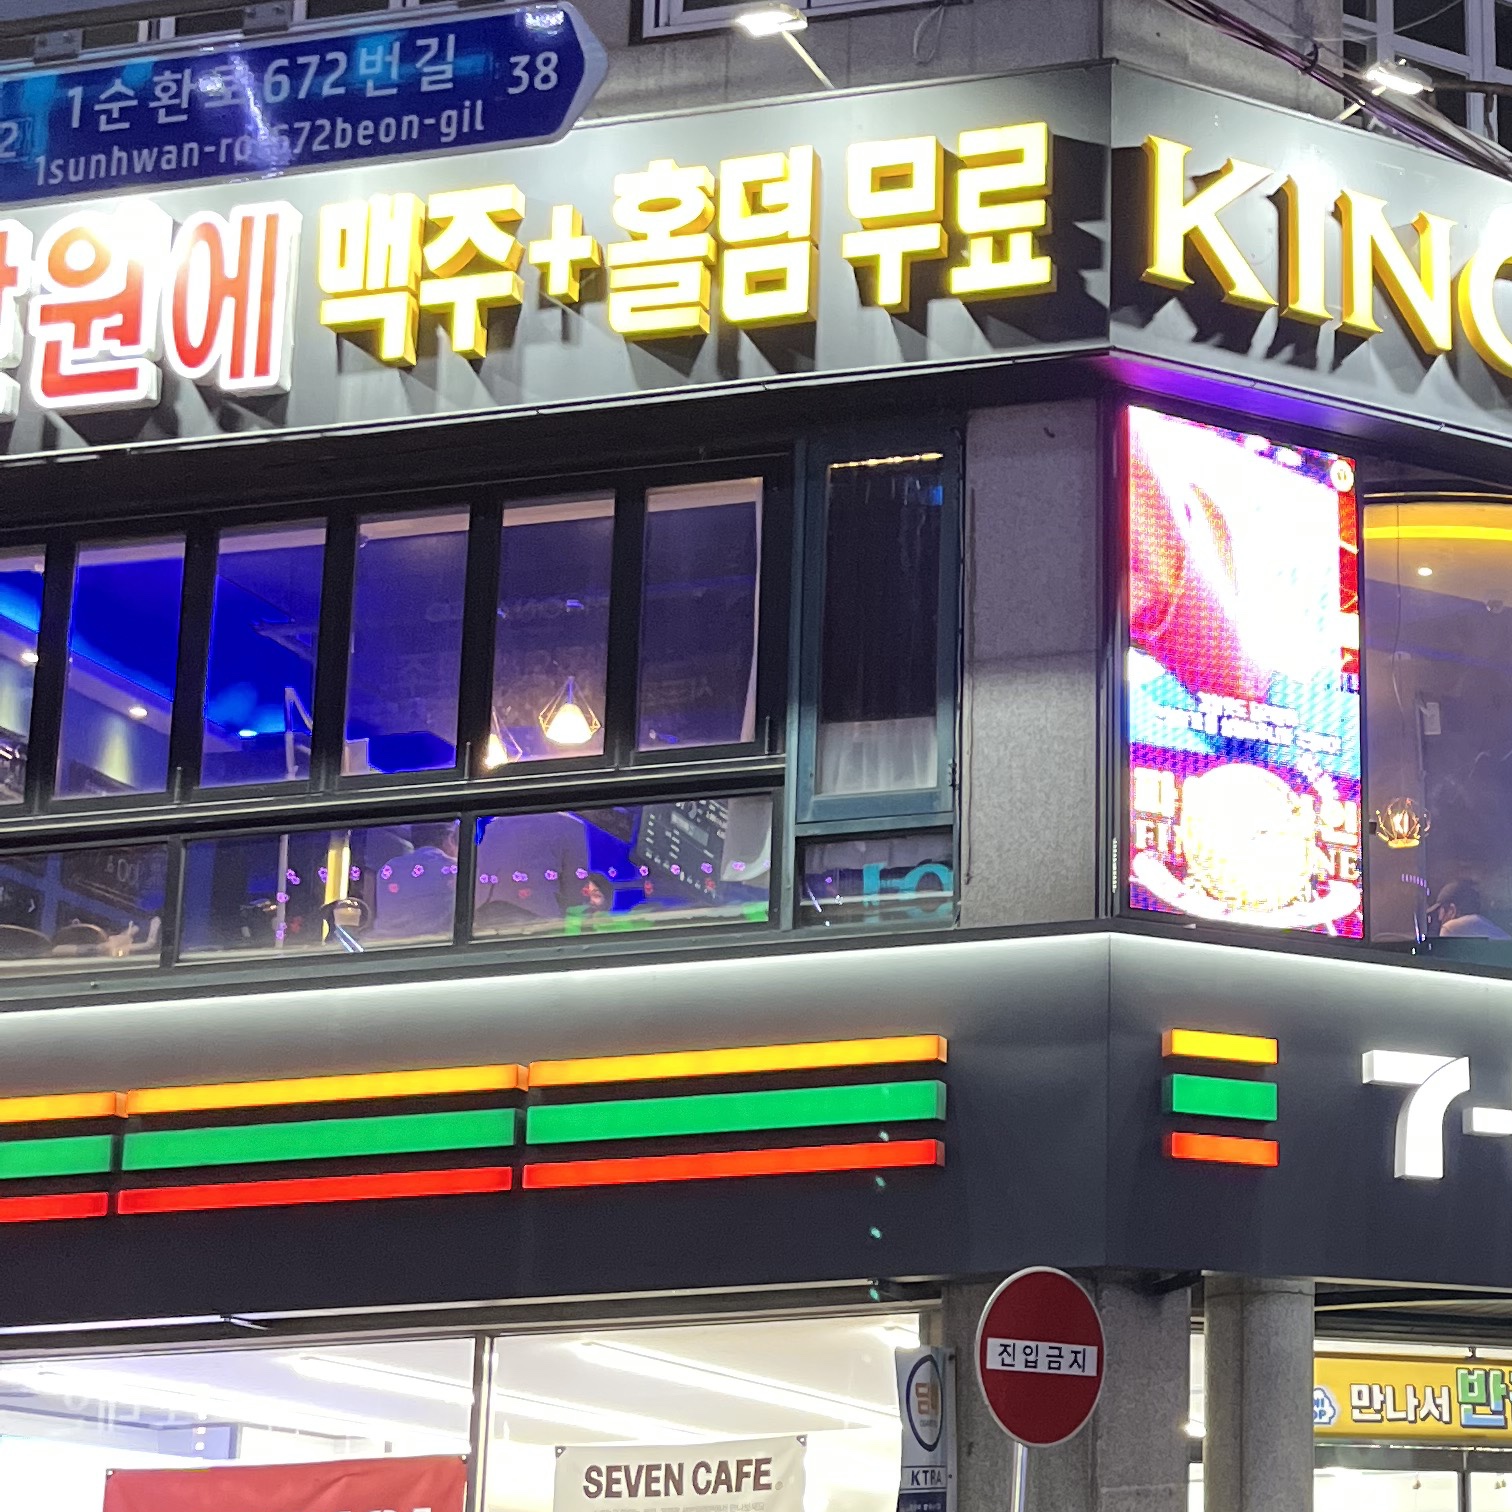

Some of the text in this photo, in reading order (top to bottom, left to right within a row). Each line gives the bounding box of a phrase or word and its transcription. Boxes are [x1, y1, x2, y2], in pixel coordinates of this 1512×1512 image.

[262, 33, 457, 105] 672번길
[507, 51, 560, 96] 38
[841, 121, 1060, 314] 무료
[998, 1342, 1087, 1373] 진입금지
[1350, 1384, 1452, 1424] 만나서
[582, 1457, 773, 1499] SEVEN CAFE
